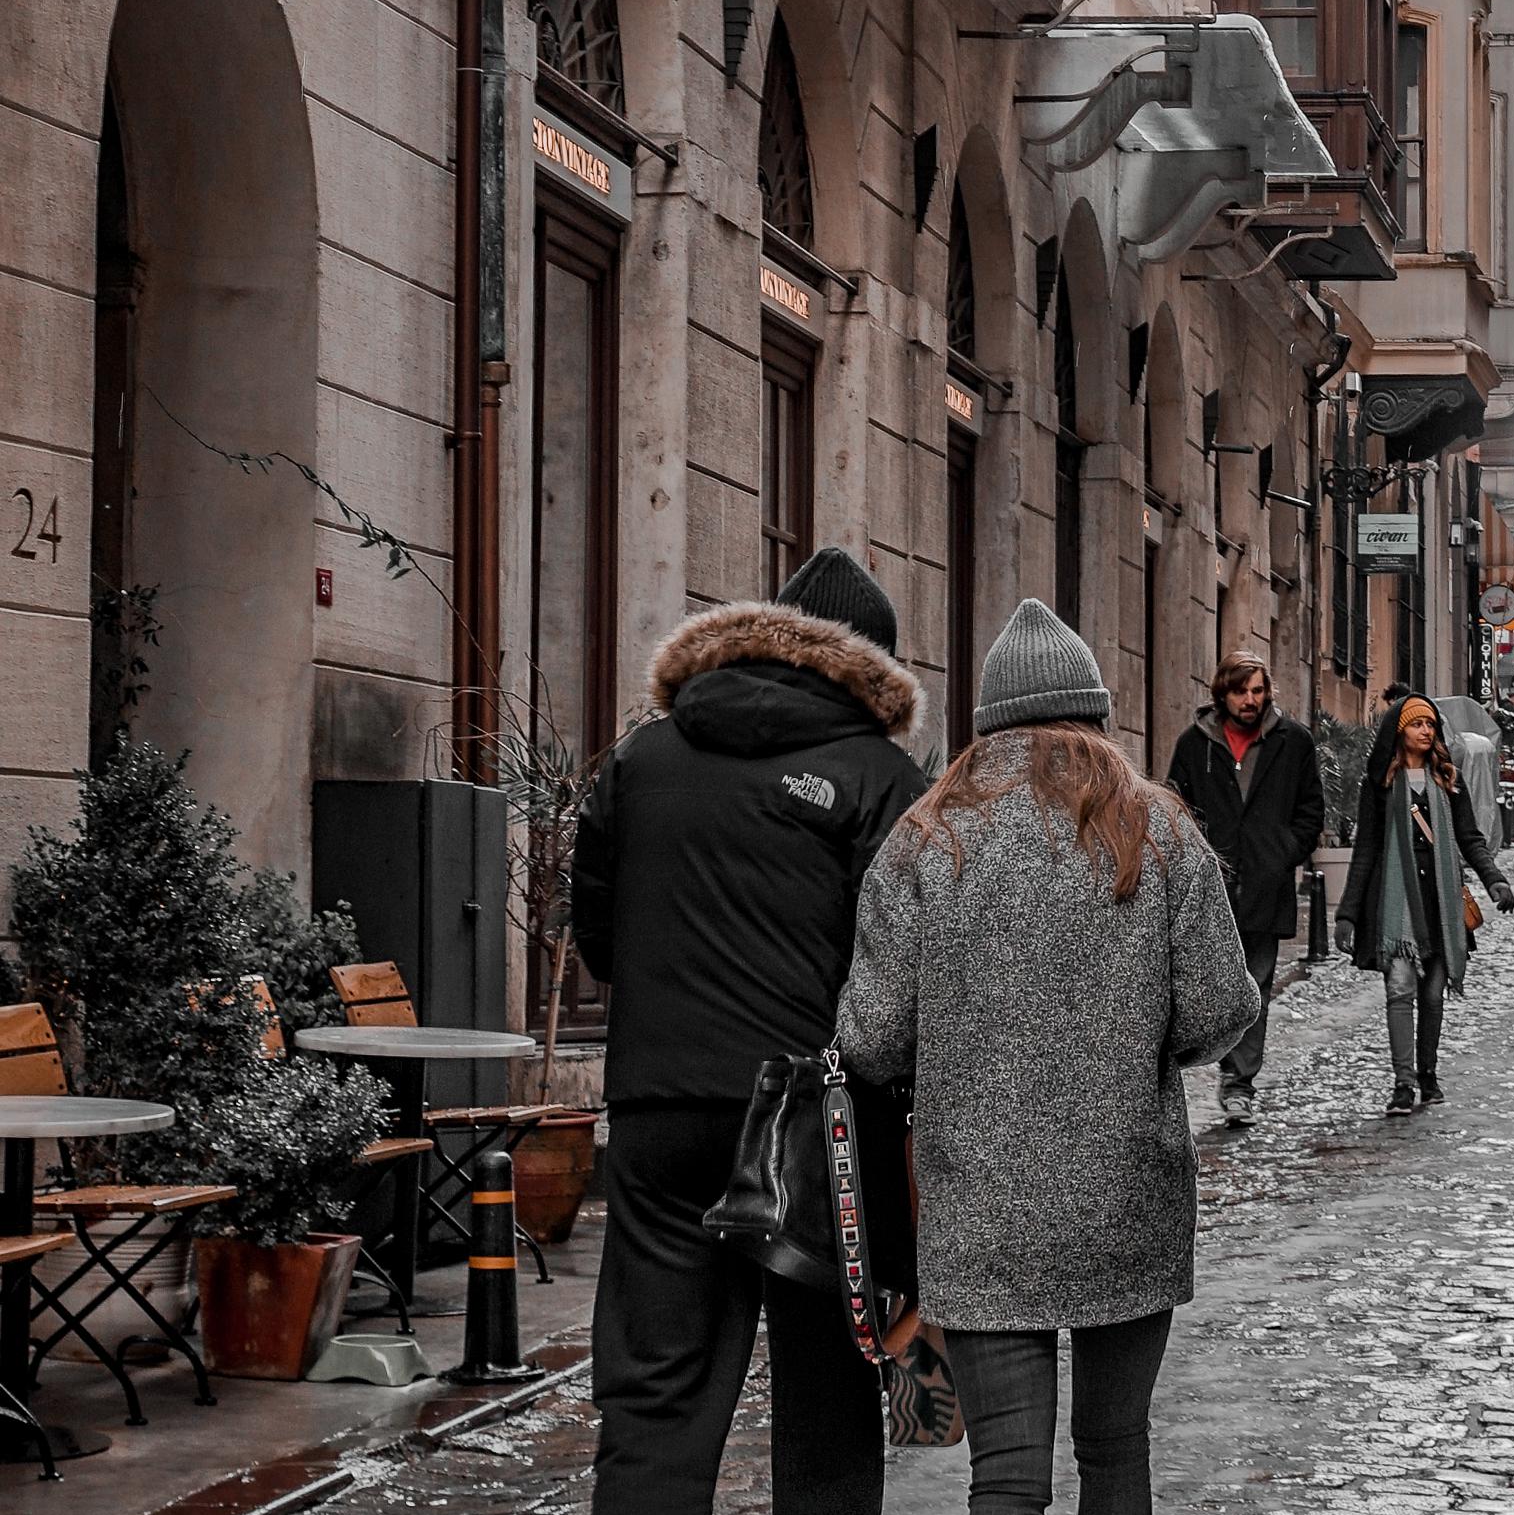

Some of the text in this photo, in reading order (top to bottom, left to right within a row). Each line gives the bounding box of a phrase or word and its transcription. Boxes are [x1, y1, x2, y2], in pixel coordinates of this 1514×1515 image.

[11, 487, 63, 565] 24
[1480, 625, 1492, 696] CLOTHING
[781, 774, 820, 794] NORTH
[802, 772, 823, 787] THE
[788, 785, 815, 804] FACE
